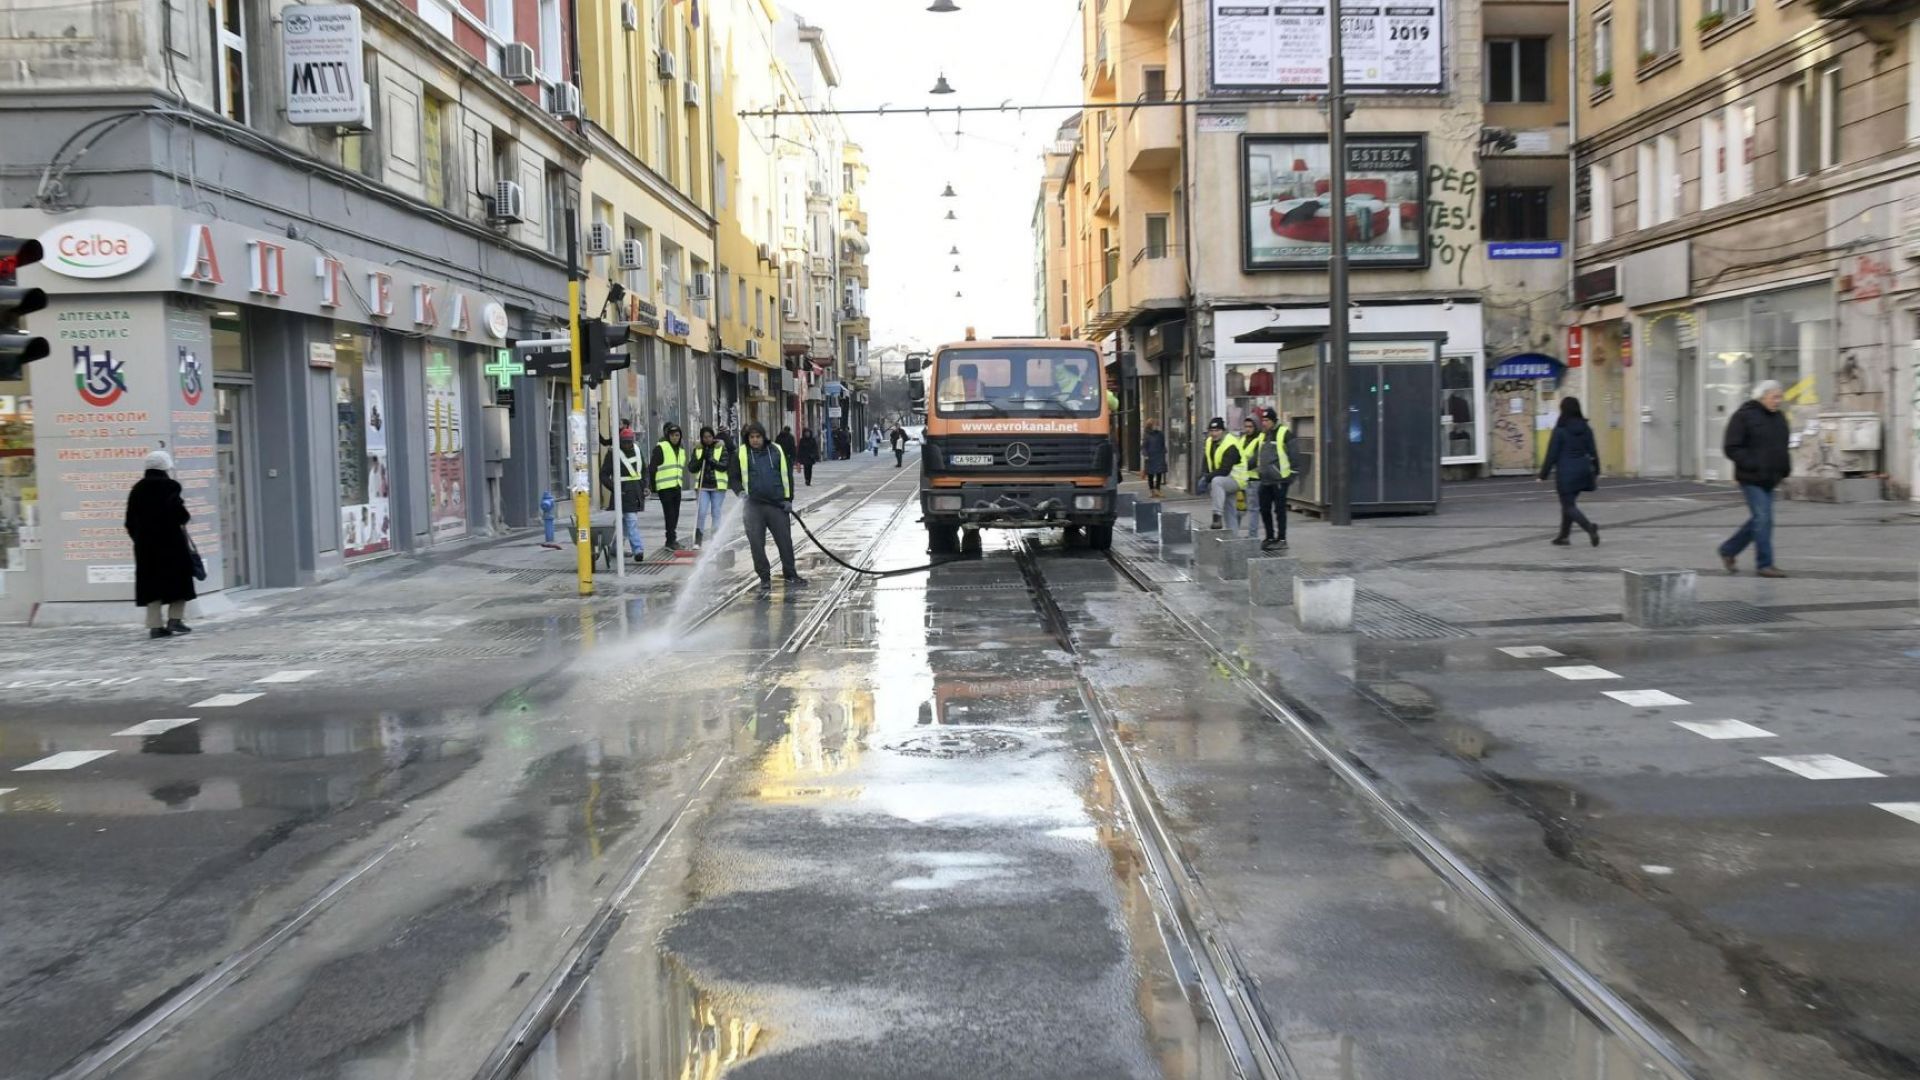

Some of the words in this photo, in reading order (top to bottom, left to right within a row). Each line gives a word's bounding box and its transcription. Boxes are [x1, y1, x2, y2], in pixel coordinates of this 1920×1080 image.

[1389, 26, 1430, 41] 2019
[1351, 149, 1411, 161] ESTETA
[58, 234, 129, 257] Ceiba
[181, 224, 472, 333] АПТЕКА
[57, 310, 131, 321] АПТЕКАТА
[60, 329, 116, 339] РАБОТИ
[56, 412, 147, 424] ПРОТОКОЛИ
[961, 421, 1078, 432] www.evrokanal.net
